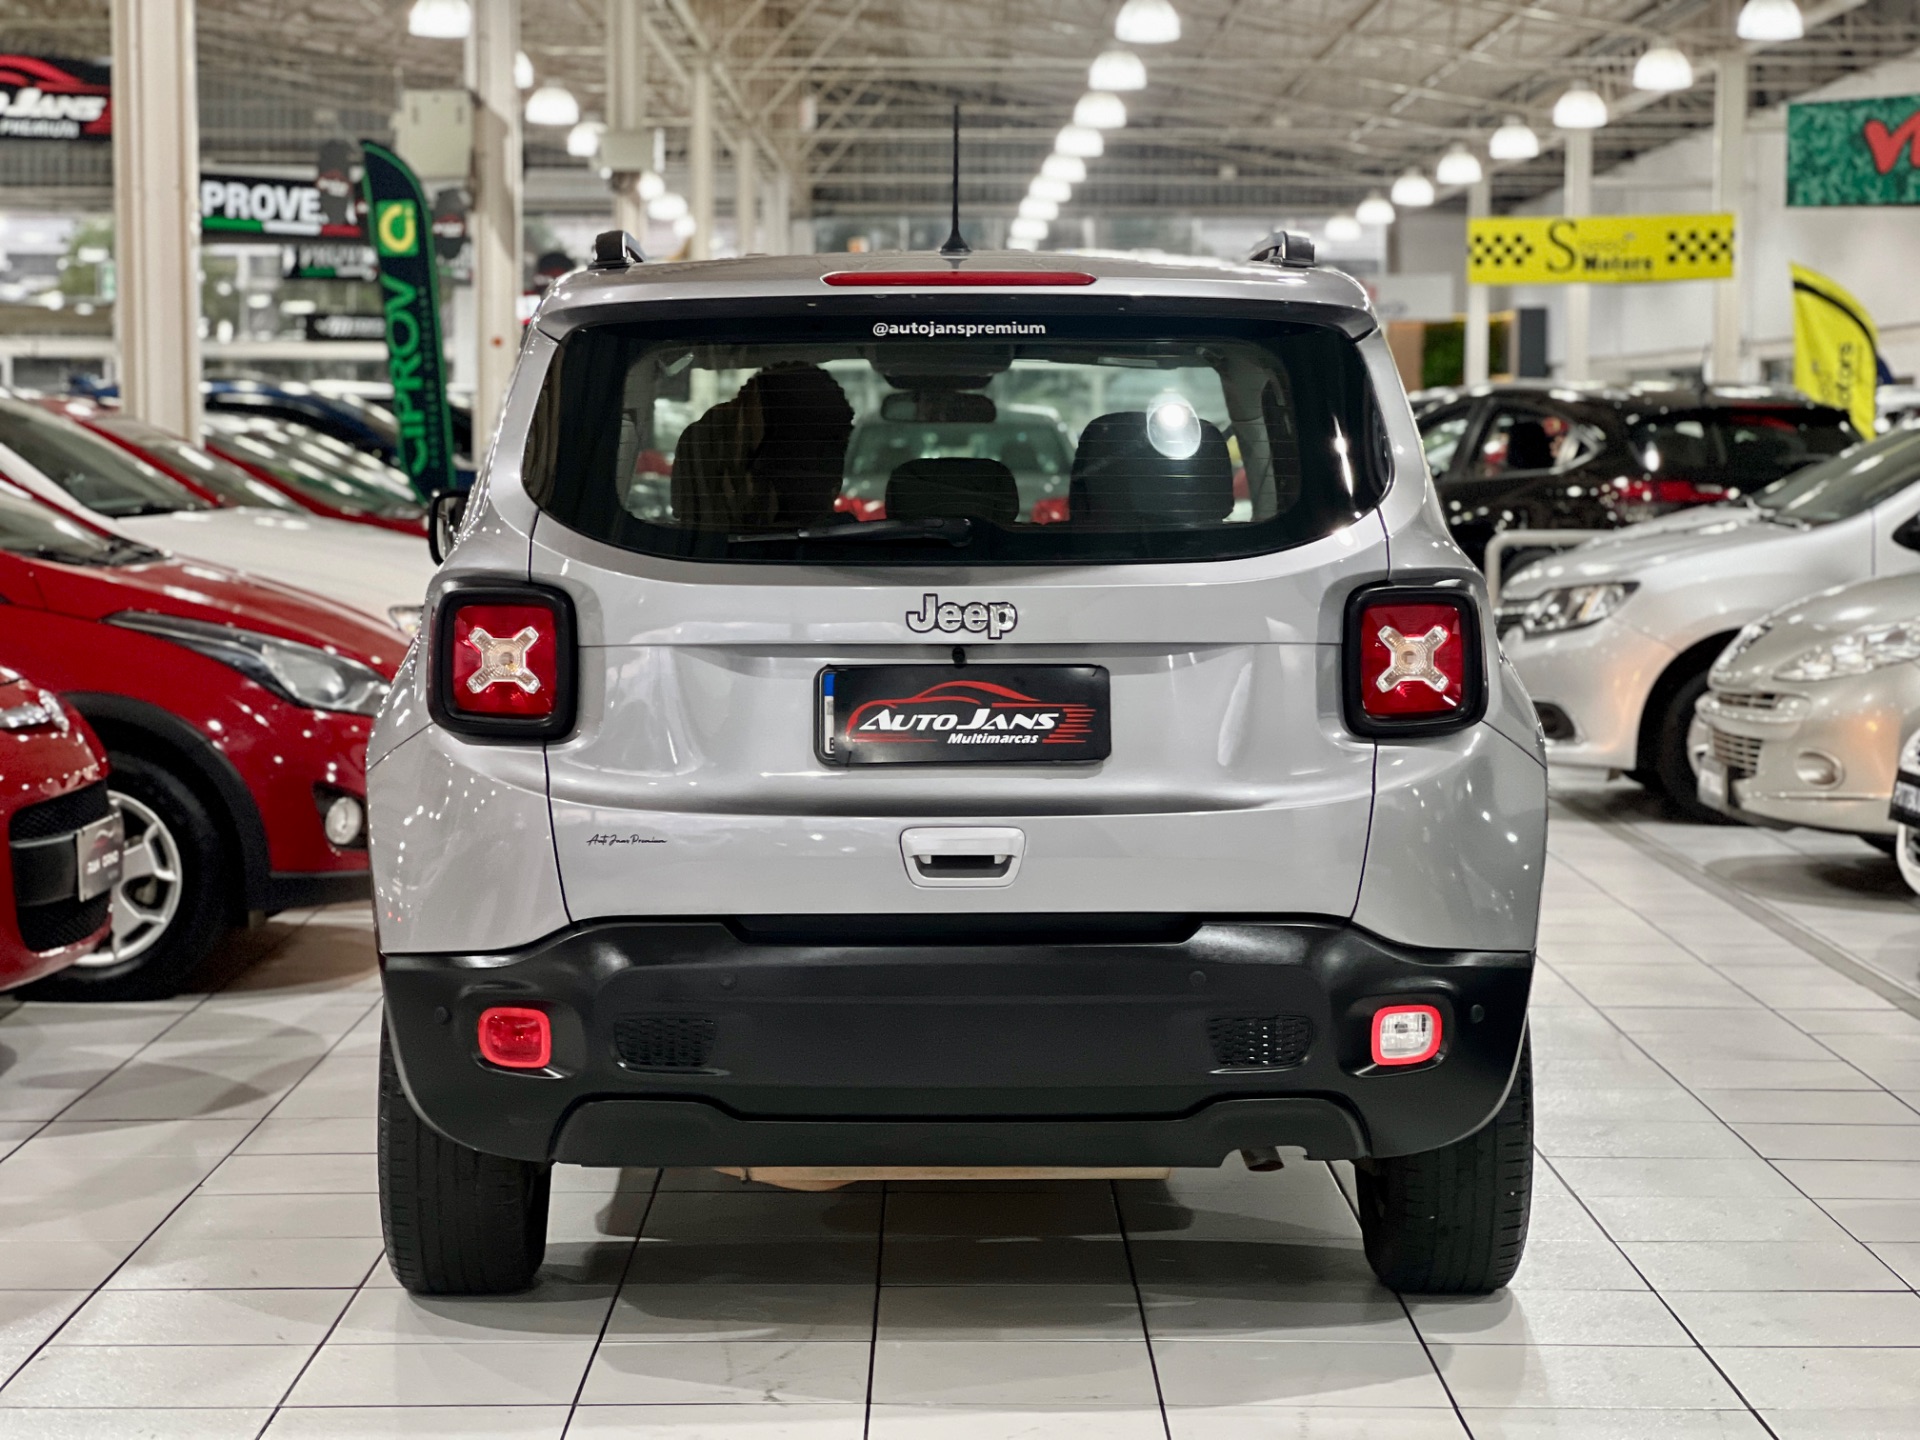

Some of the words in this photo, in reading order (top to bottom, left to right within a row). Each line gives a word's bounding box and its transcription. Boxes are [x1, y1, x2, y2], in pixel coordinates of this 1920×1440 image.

[872, 321, 1046, 337] @autojanspremium
[906, 593, 1018, 640] Jeep
[947, 733, 1039, 744] Multimarcas
